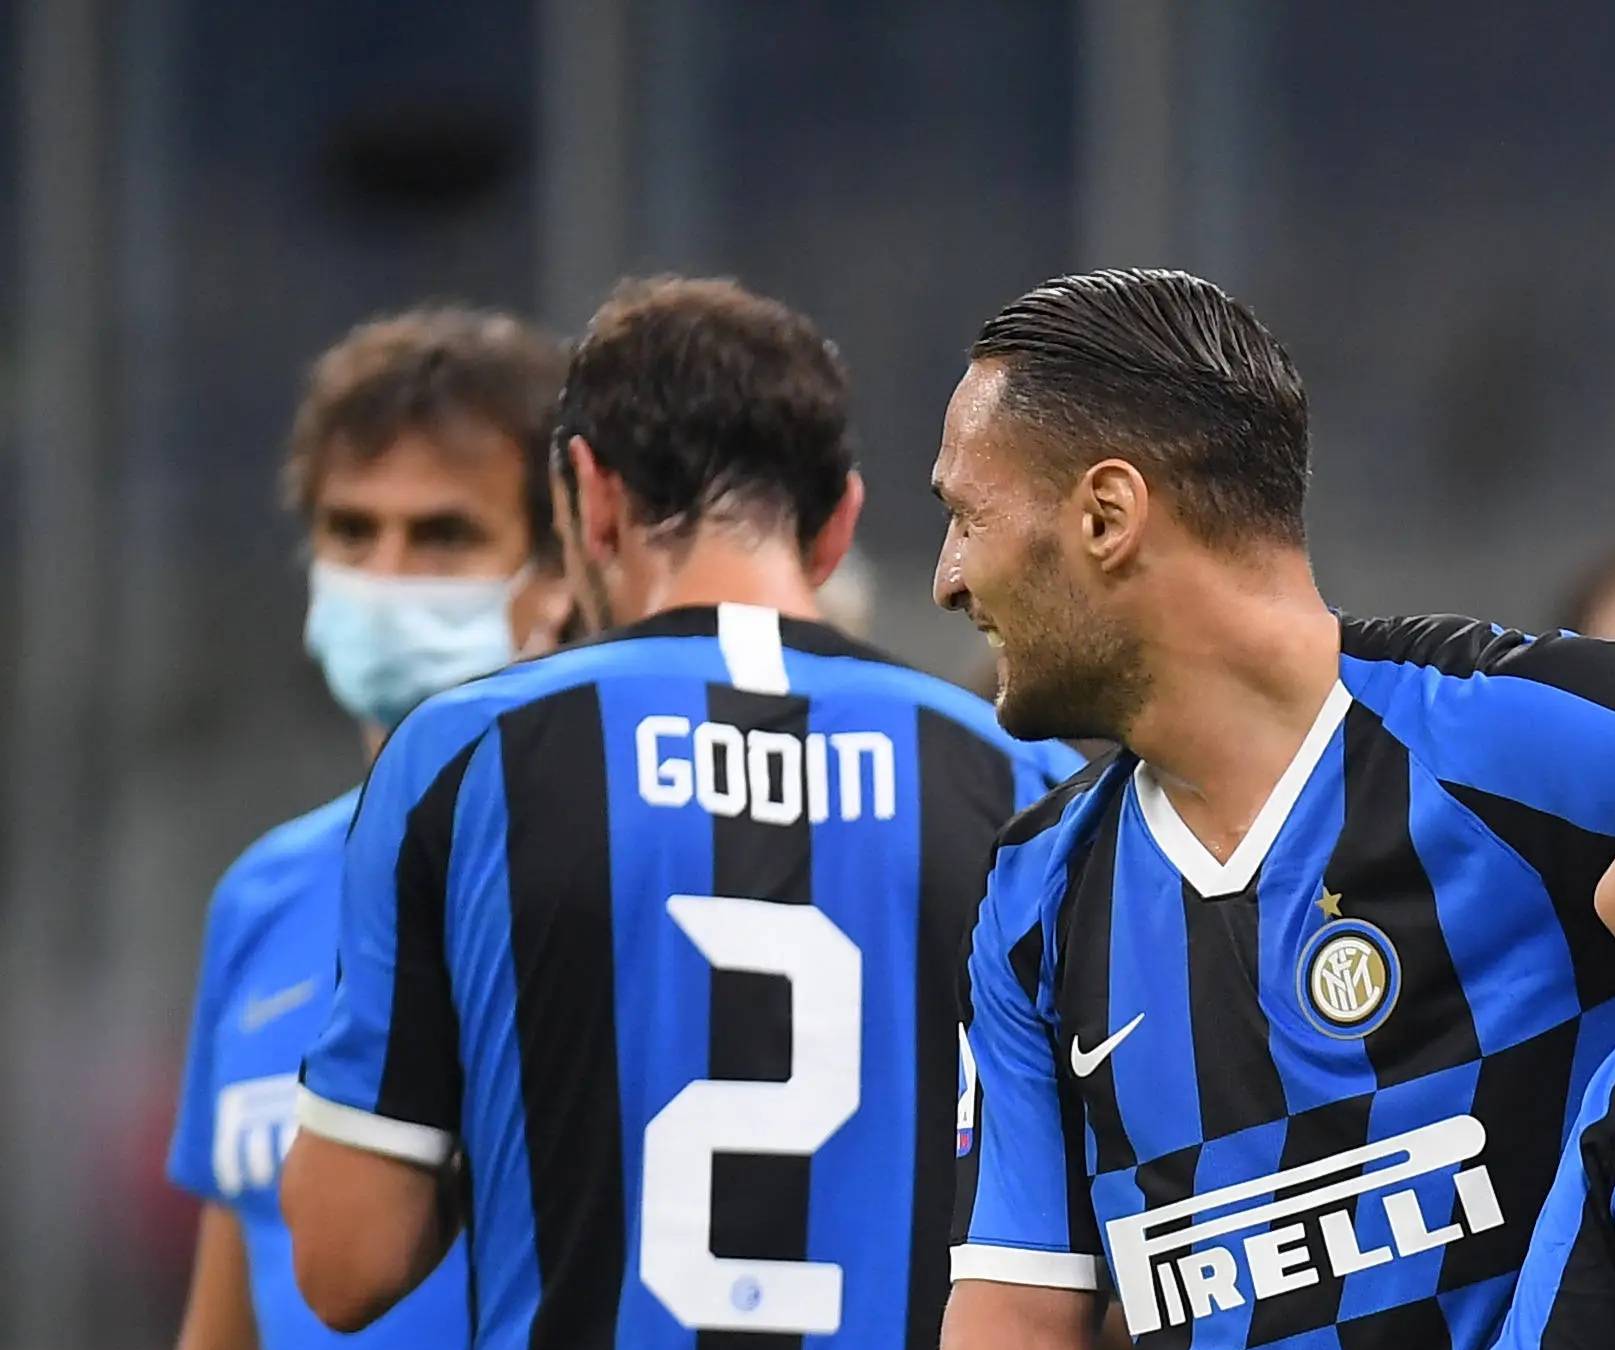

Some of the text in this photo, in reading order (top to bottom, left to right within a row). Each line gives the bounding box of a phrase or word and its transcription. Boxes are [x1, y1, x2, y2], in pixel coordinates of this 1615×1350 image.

[635, 714, 896, 826] GODIN
[640, 894, 862, 1336] 2
[1106, 1114, 1505, 1336] PIRELLI
